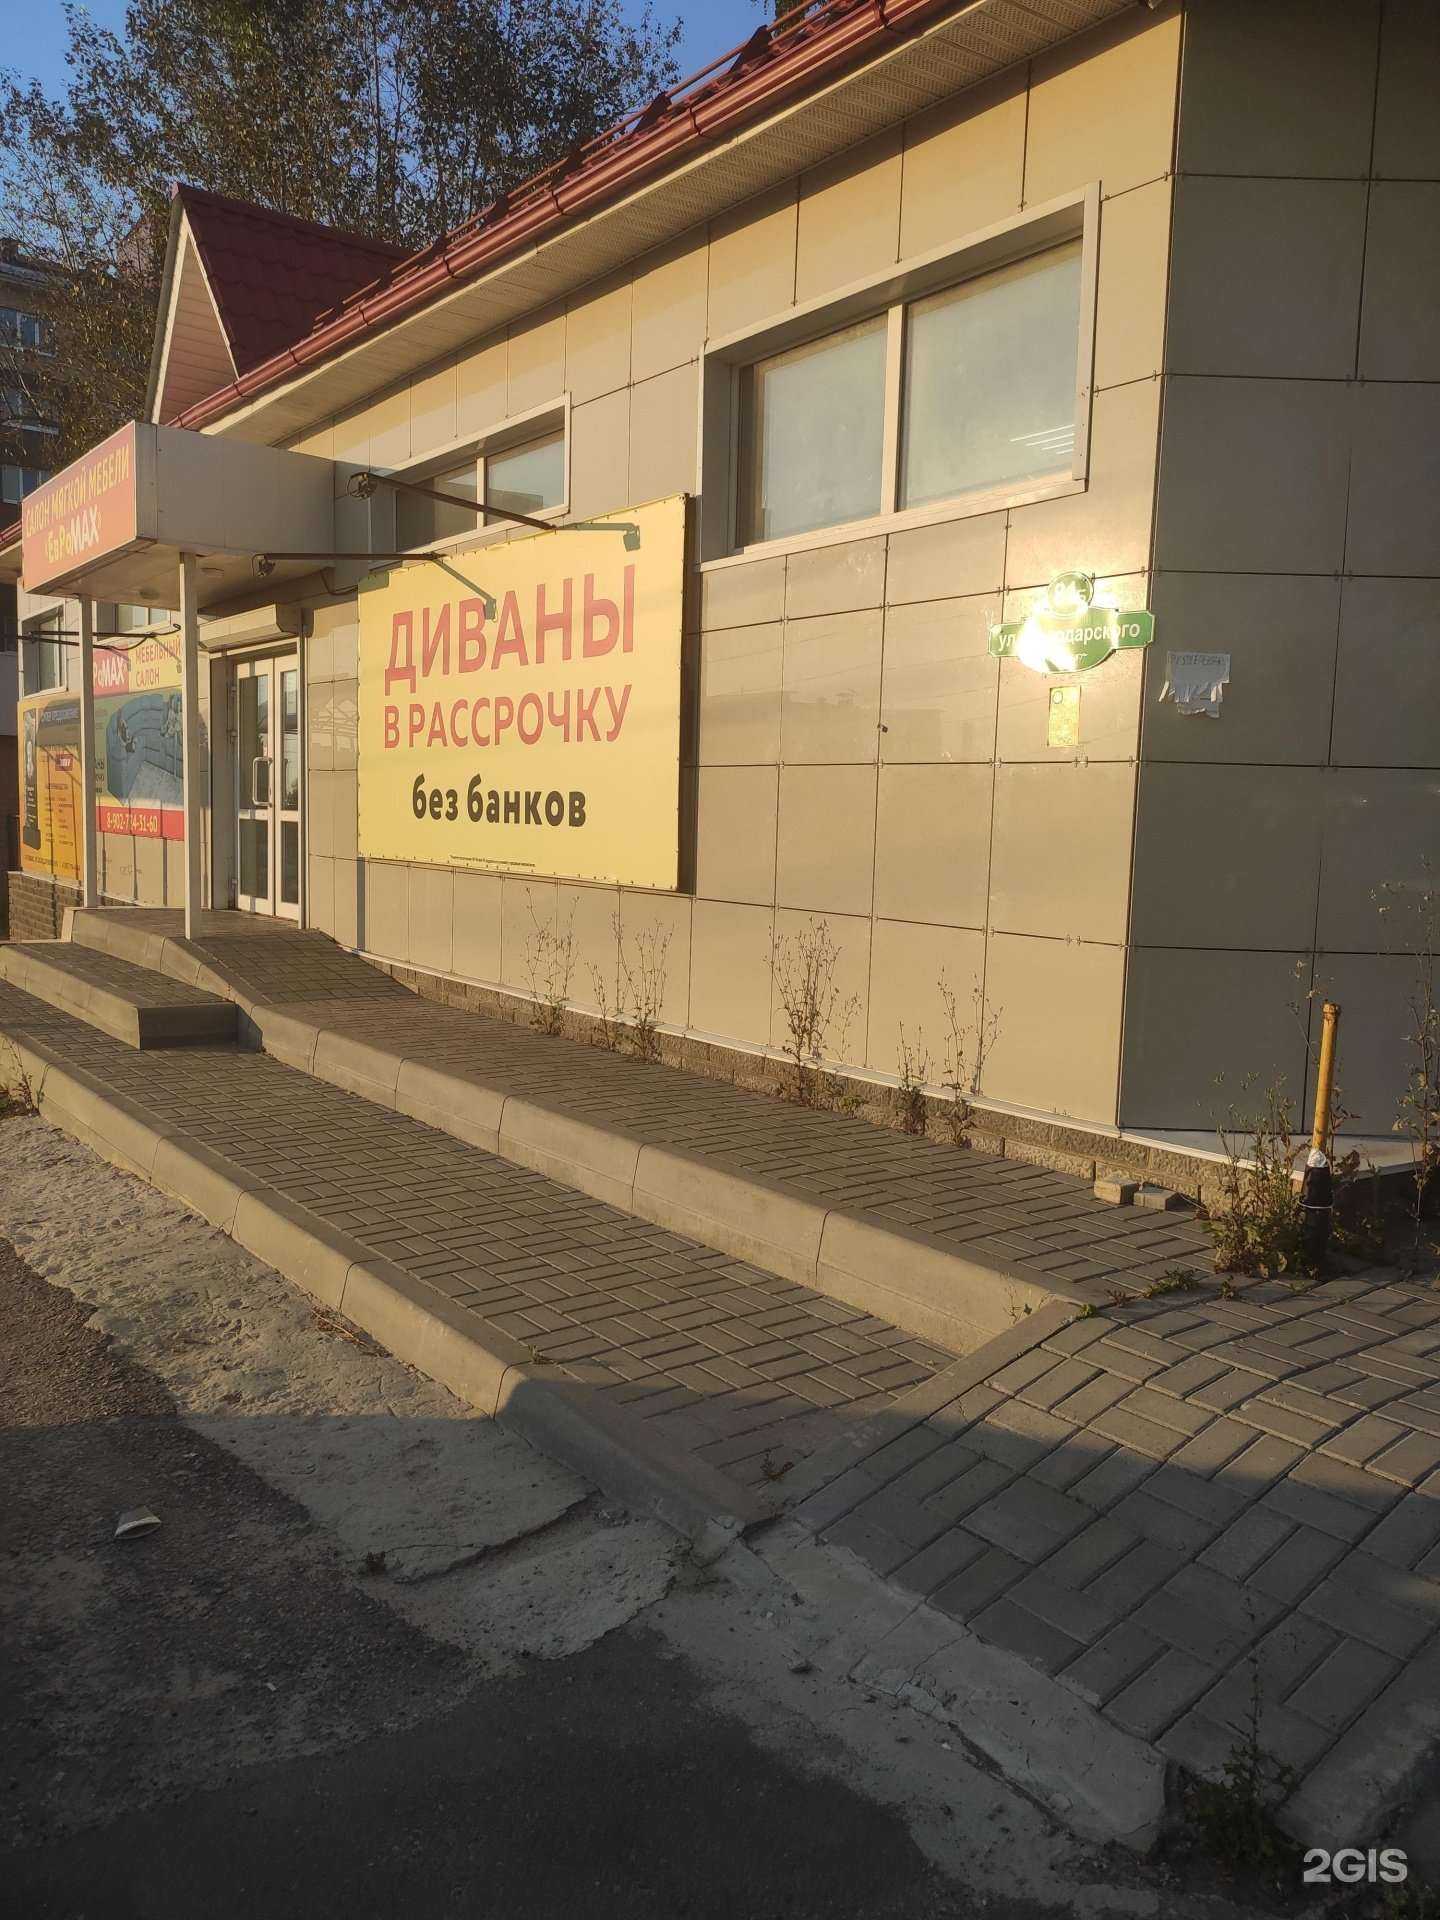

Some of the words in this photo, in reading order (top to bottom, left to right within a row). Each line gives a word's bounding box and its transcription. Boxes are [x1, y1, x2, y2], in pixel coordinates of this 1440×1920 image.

[26, 494, 49, 538] САЛОН
[52, 465, 86, 521] МЯГКОЙ
[89, 443, 129, 498] МЕБЕЛИ
[135, 635, 181, 665] МЕБЕЛЬНЫЙ
[384, 563, 636, 697] ДИВАНЫ
[136, 667, 160, 688] САЛОН
[384, 704, 400, 749] В
[408, 684, 633, 748] РАССРОЧКУ
[412, 773, 459, 821] без
[467, 773, 587, 828] банков
